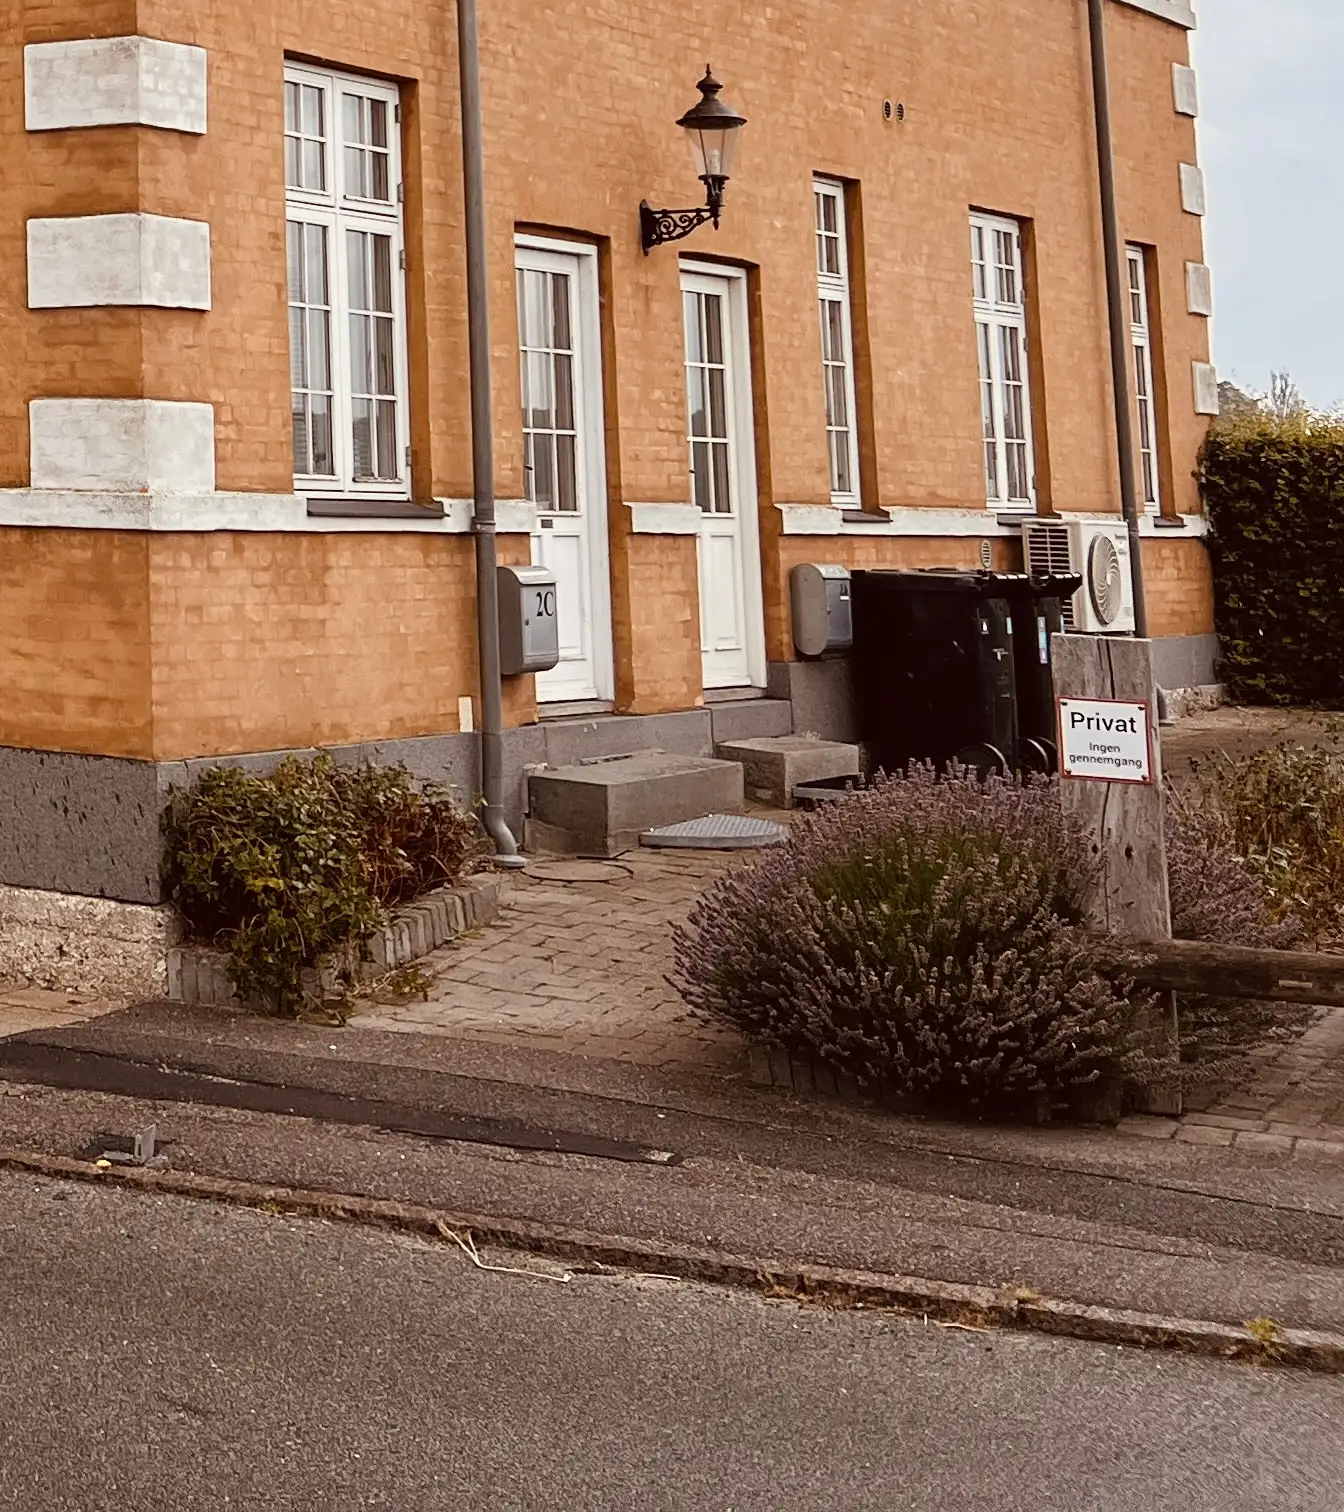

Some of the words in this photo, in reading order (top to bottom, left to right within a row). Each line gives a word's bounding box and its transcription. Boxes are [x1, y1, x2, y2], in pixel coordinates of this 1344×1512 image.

[536, 591, 554, 617] 2C
[1070, 711, 1137, 734] Privat
[1089, 741, 1121, 754] Ingen
[1069, 754, 1143, 769] gennemgang
